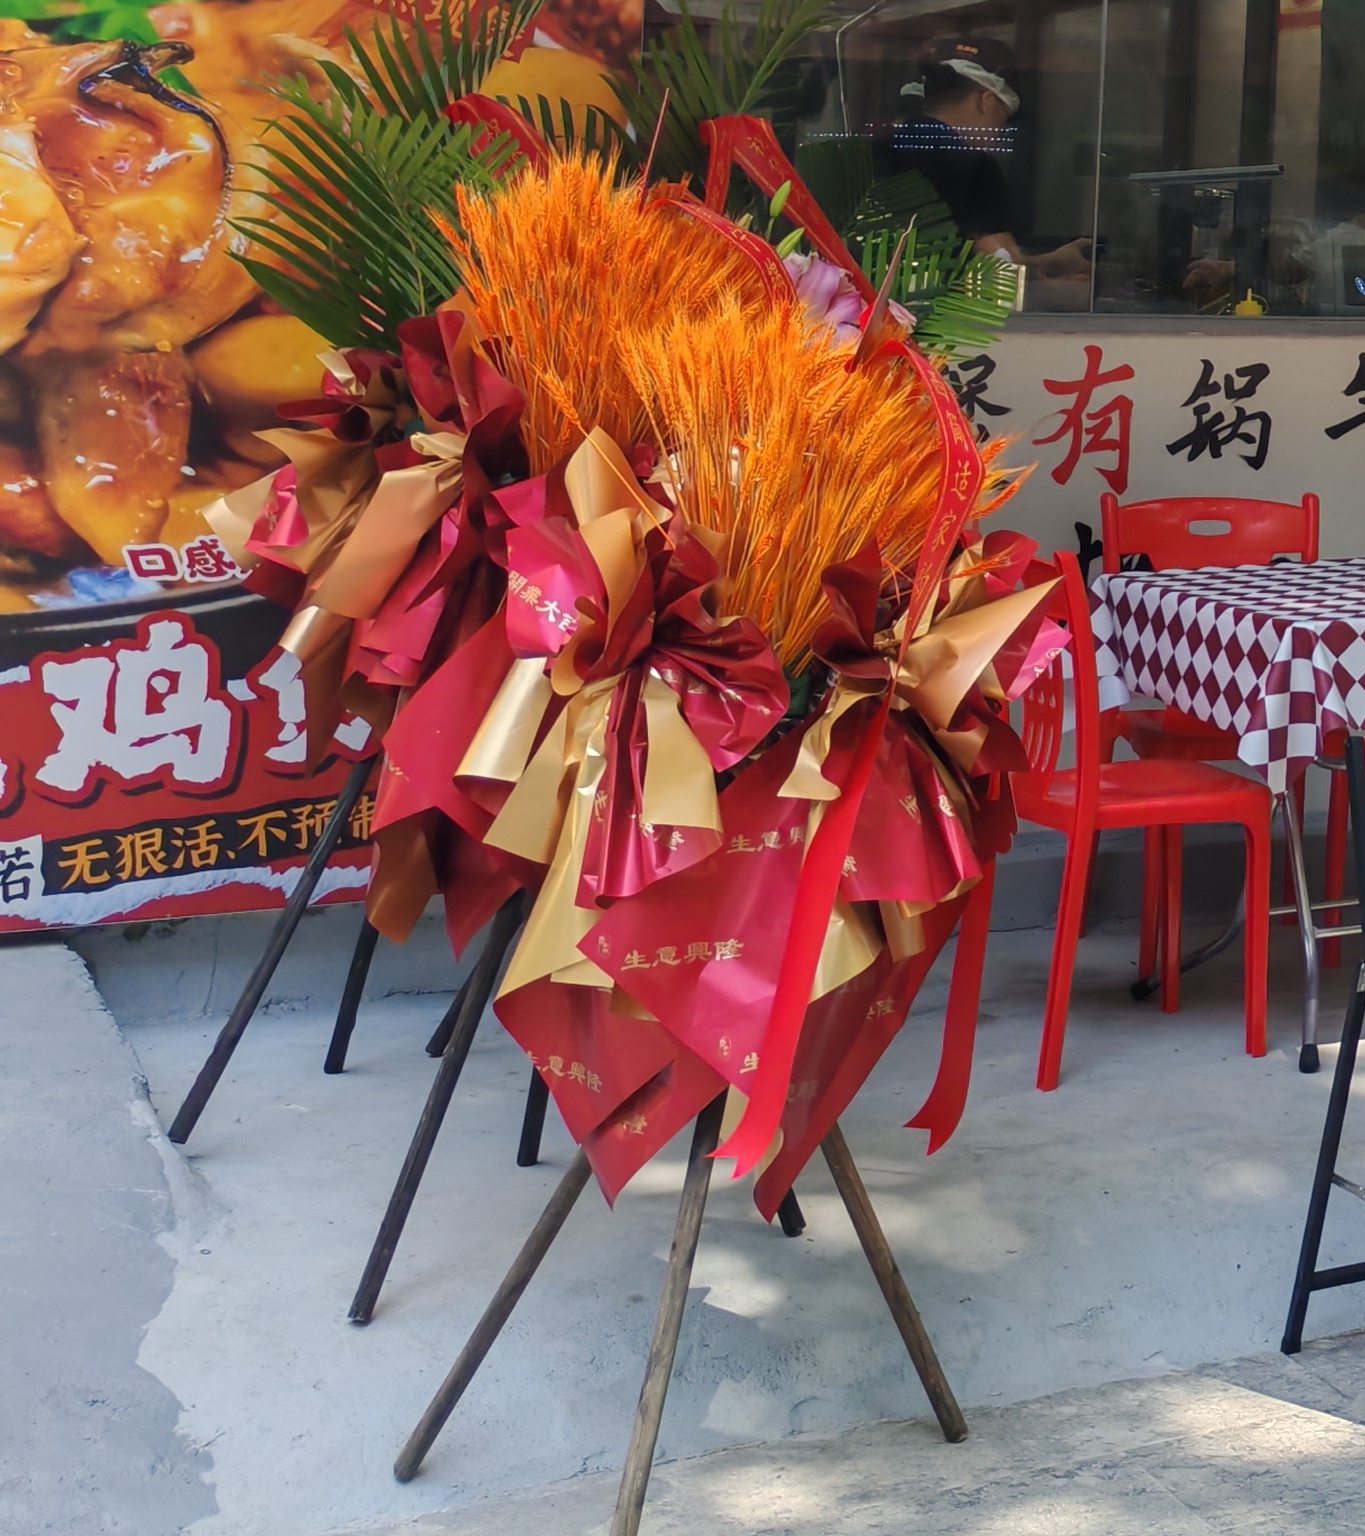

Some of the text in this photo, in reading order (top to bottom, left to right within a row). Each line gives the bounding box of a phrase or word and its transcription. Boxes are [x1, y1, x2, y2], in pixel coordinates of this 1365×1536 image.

[126, 539, 240, 582] 口感
[620, 937, 745, 972] 生意興隆
